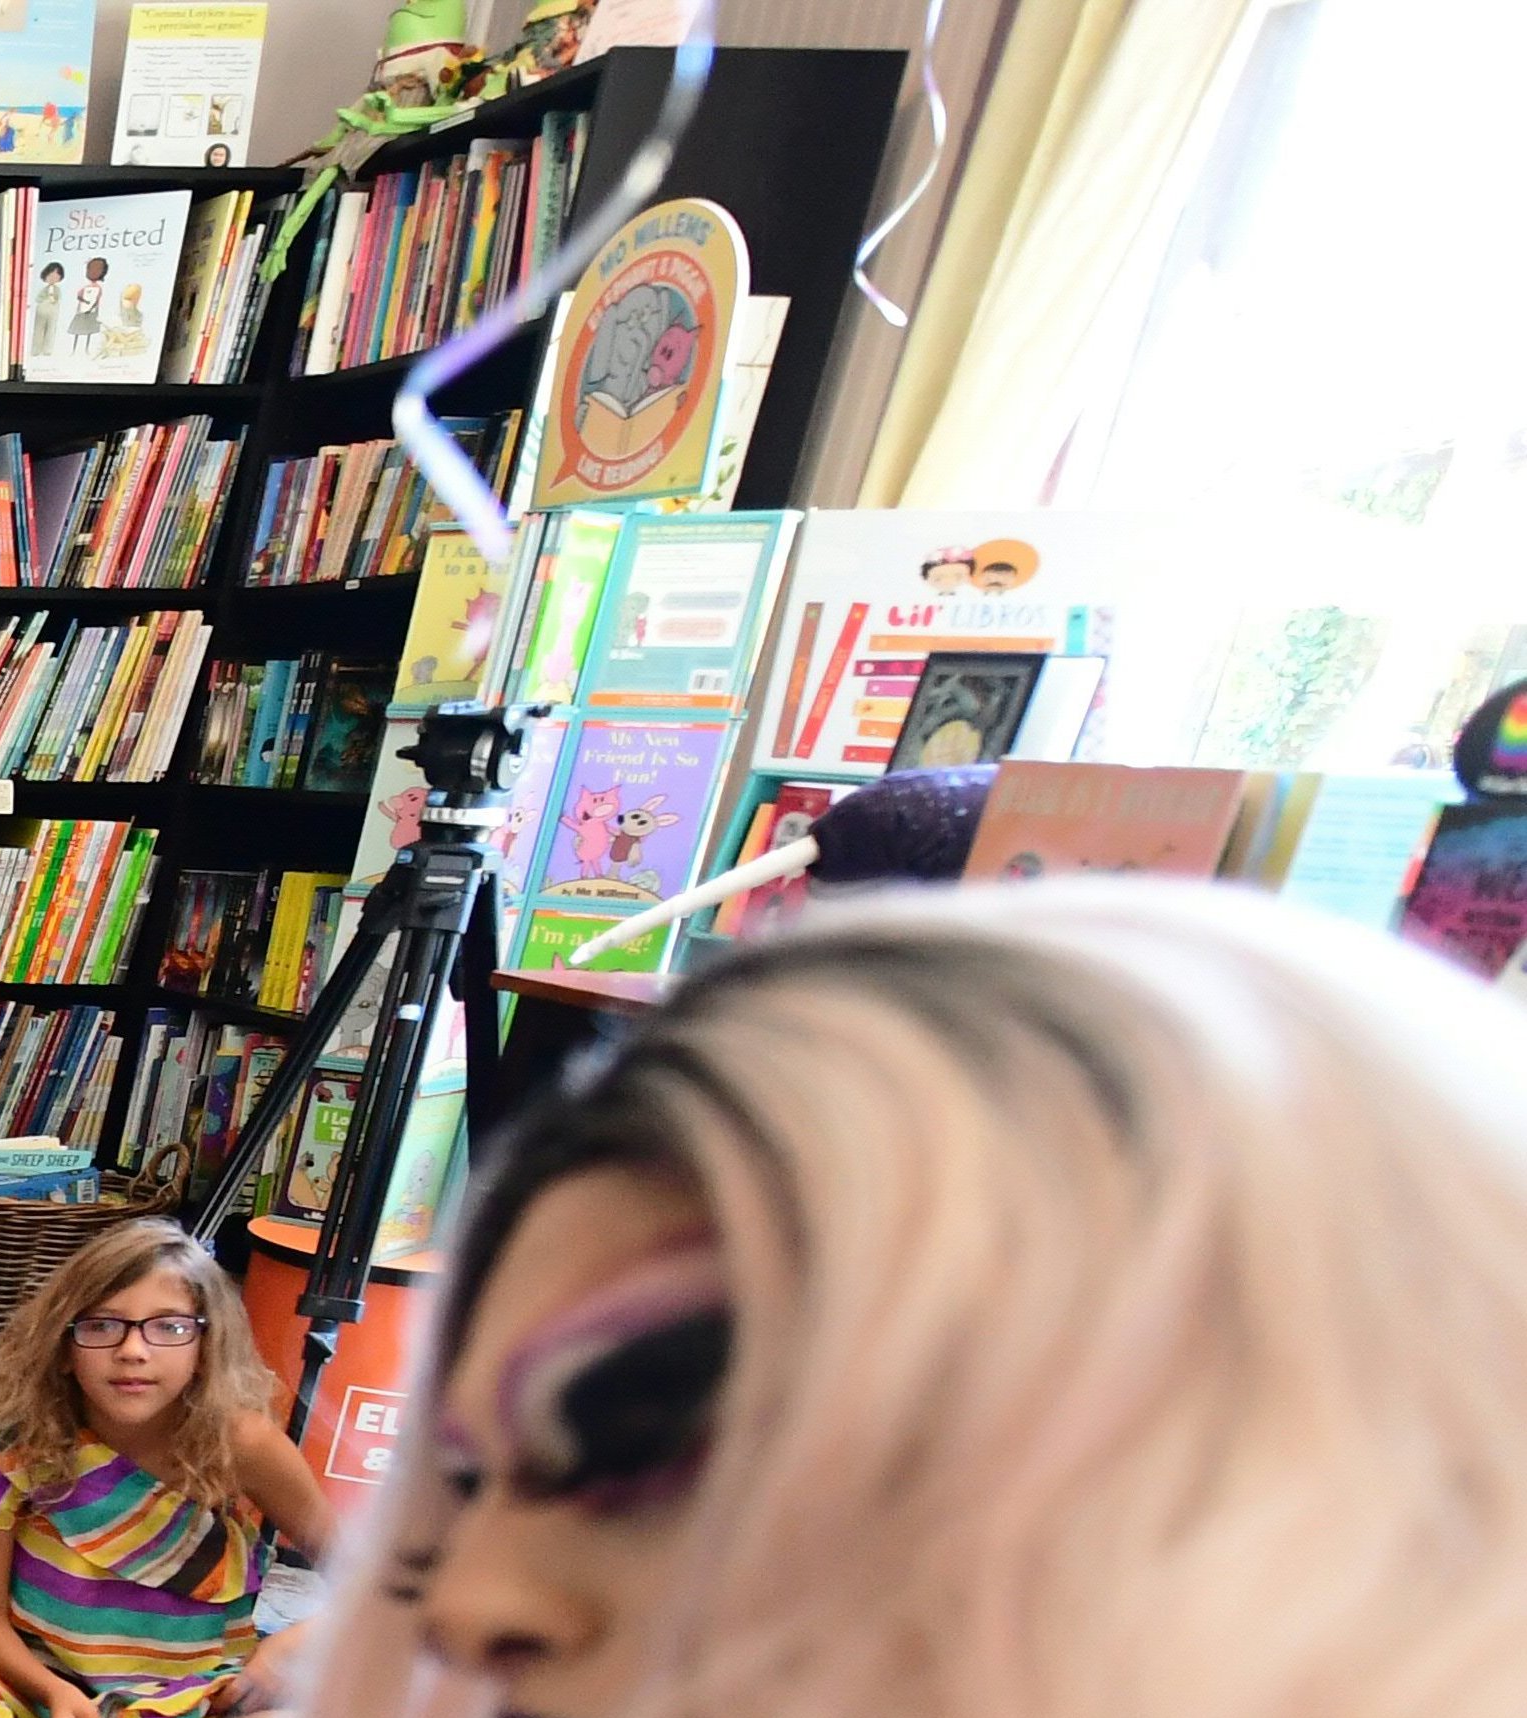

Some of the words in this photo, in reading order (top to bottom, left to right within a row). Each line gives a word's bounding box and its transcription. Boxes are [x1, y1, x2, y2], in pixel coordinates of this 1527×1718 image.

[68, 208, 106, 230] She
[45, 218, 167, 253] Persisted
[445, 564, 461, 575] to
[951, 604, 1045, 628] LIBROS
[610, 732, 633, 749] My
[645, 732, 680, 746] New
[583, 750, 646, 765] Friend
[651, 752, 667, 765] Is
[676, 752, 699, 767] So
[613, 770, 657, 785] Fun!
[531, 925, 564, 945] I'm
[570, 933, 584, 946] a
[11, 1154, 44, 1167] SHEEP
[46, 1154, 80, 1167] SHEEP
